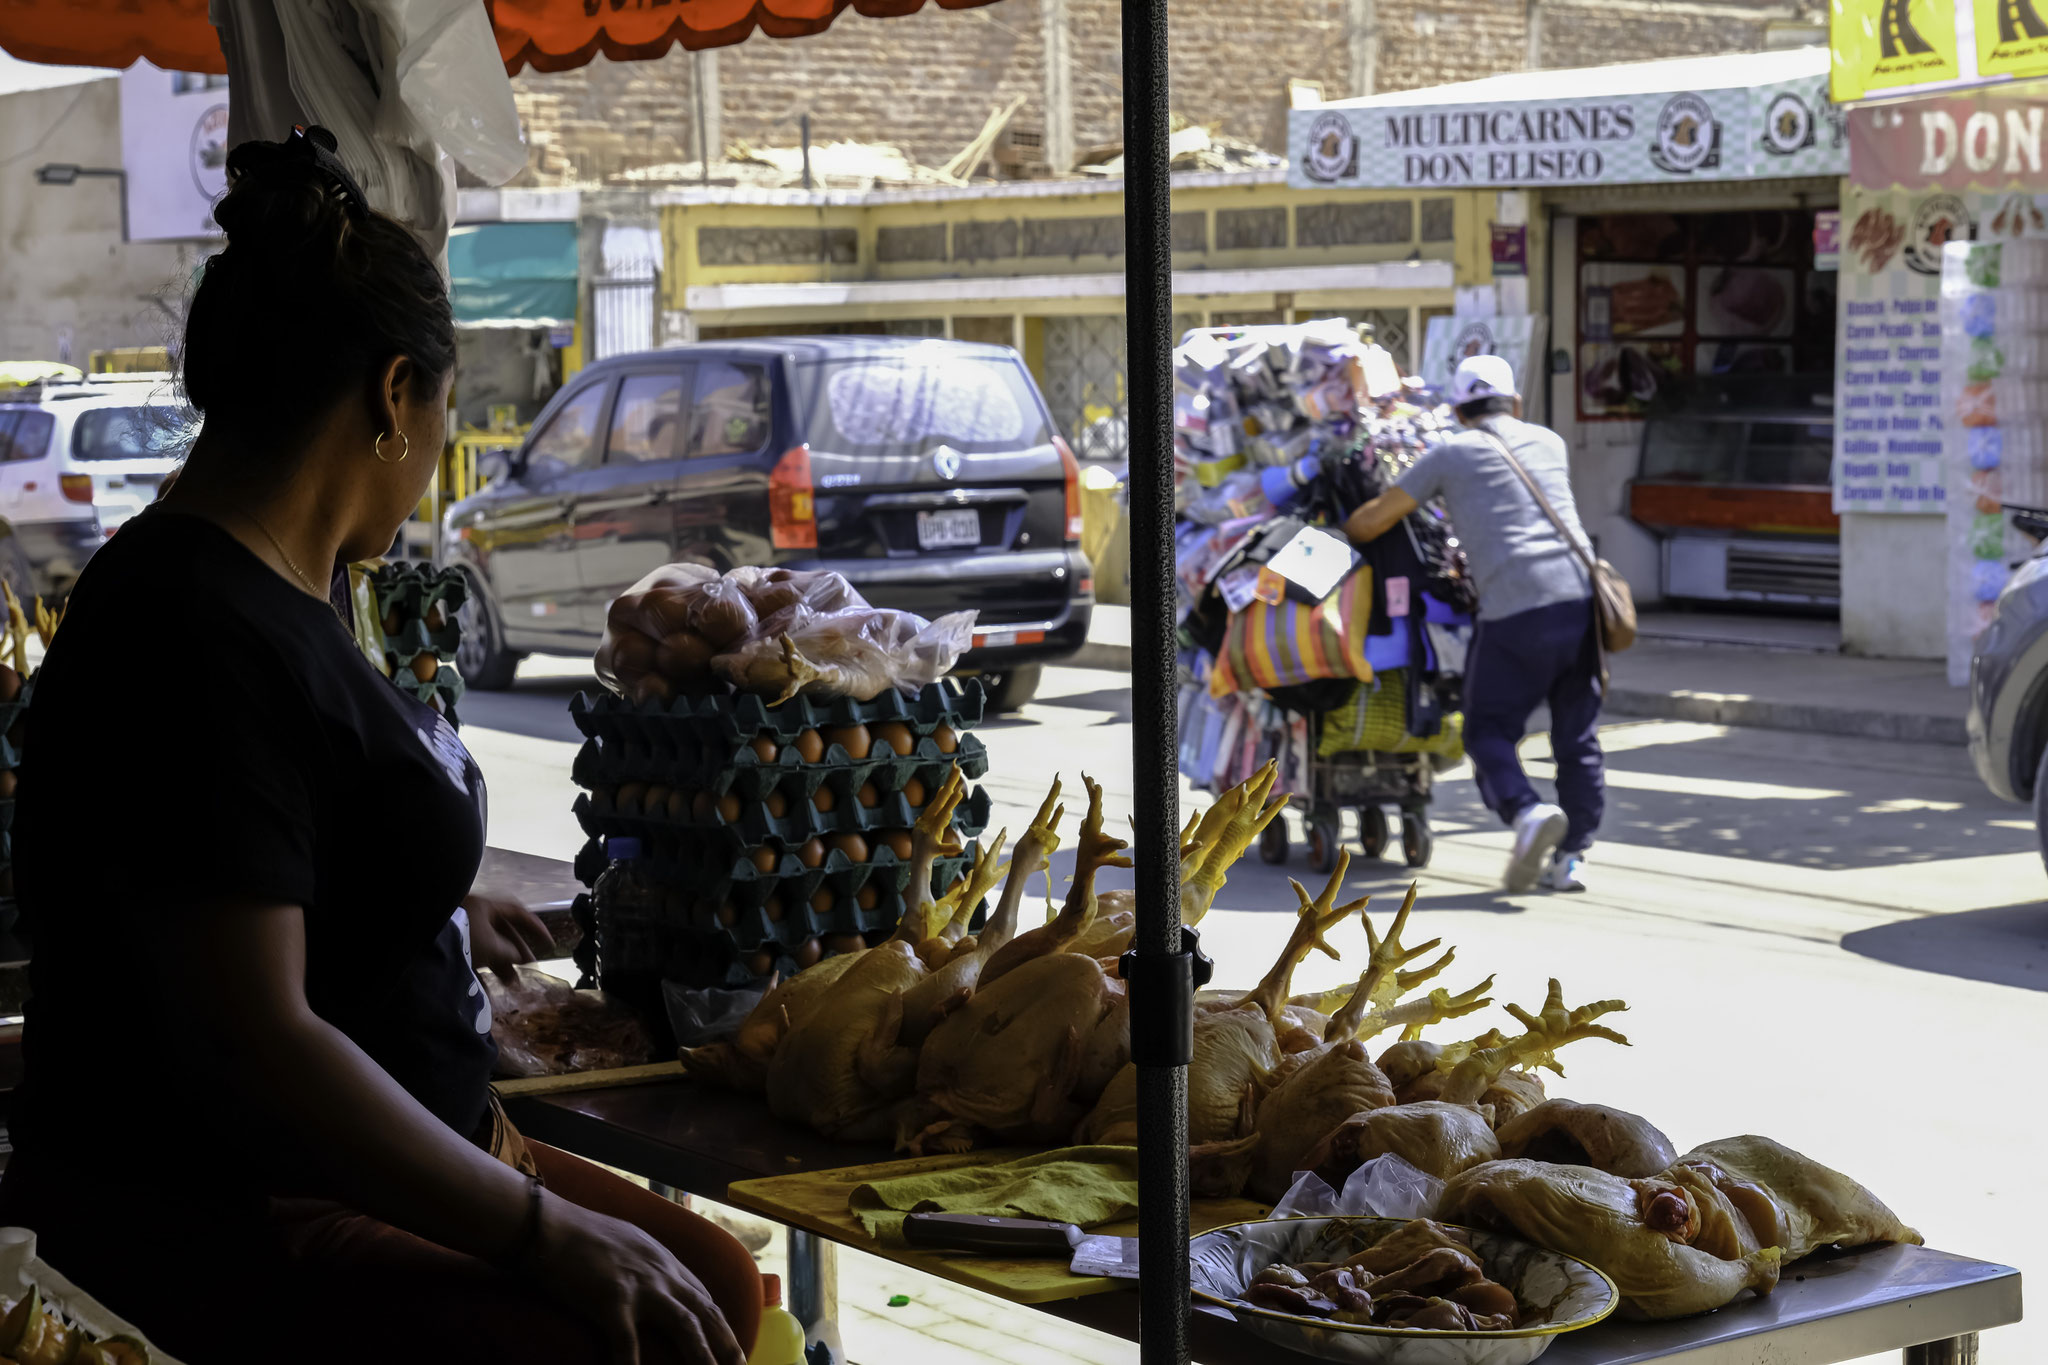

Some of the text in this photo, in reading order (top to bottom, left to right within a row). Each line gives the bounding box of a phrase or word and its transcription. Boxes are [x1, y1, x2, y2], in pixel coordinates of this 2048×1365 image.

[1384, 104, 1635, 148] MULTICARNES
[1920, 108, 2044, 175] DON
[1405, 148, 1604, 184] DON ELISEO
[1924, 299, 1936, 313] de
[1847, 325, 1875, 338] Carne
[1846, 371, 1874, 385] Carne
[1845, 393, 1933, 408] Lomo Fino Carne
[1844, 418, 1873, 432] Carne
[1877, 418, 1888, 431] de
[1844, 440, 1879, 454] Gallina
[1891, 485, 1914, 500] Pata
[1918, 487, 1930, 501] de
